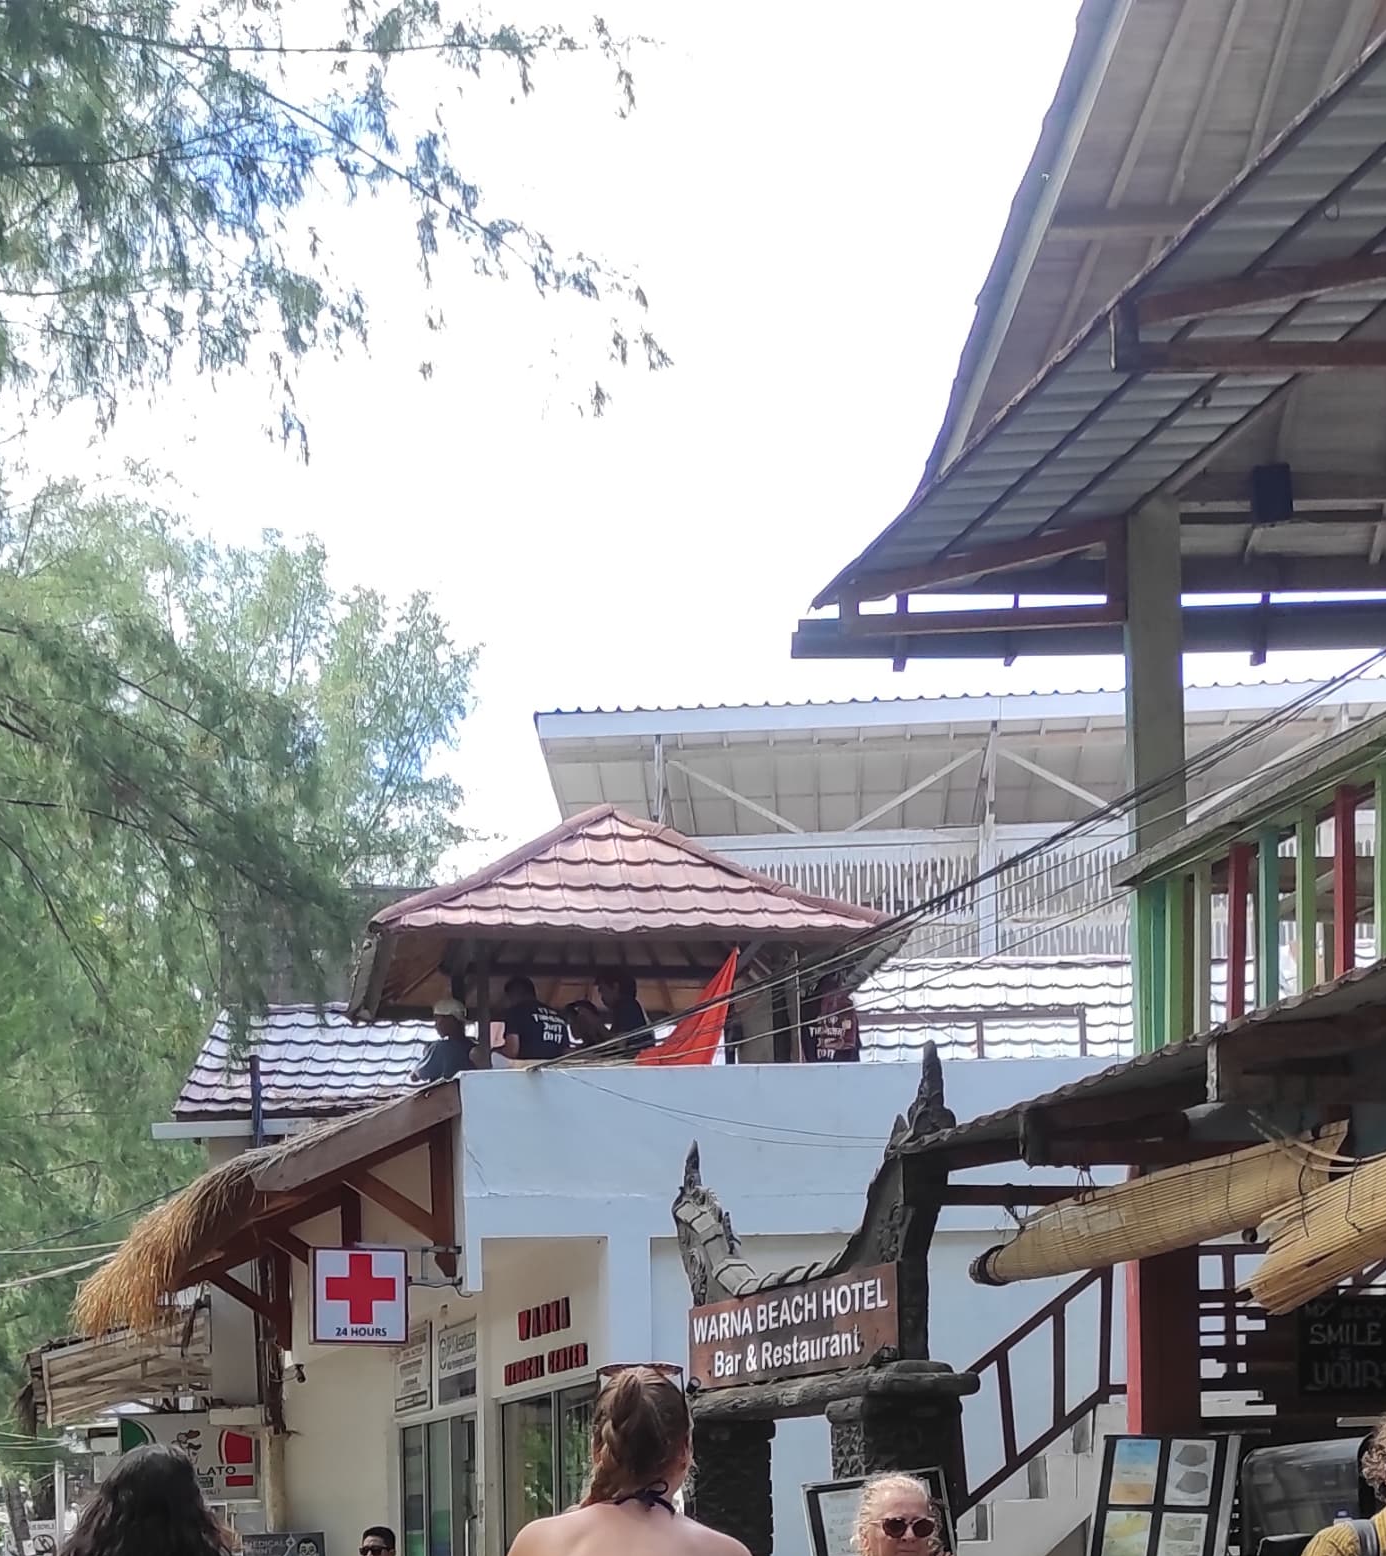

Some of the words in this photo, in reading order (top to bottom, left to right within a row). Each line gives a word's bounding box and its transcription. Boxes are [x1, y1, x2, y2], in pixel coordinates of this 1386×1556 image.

[693, 1307, 754, 1345] WARNA
[757, 1291, 818, 1333] BEACH
[822, 1277, 889, 1319] HOTEL
[335, 1327, 348, 1337] 24
[350, 1327, 388, 1338] HOURS
[1309, 1322, 1383, 1346] SMILE
[714, 1351, 742, 1378] Bar
[745, 1344, 757, 1373] &
[761, 1324, 862, 1369] Restaurant
[196, 1465, 236, 1477] LATO
